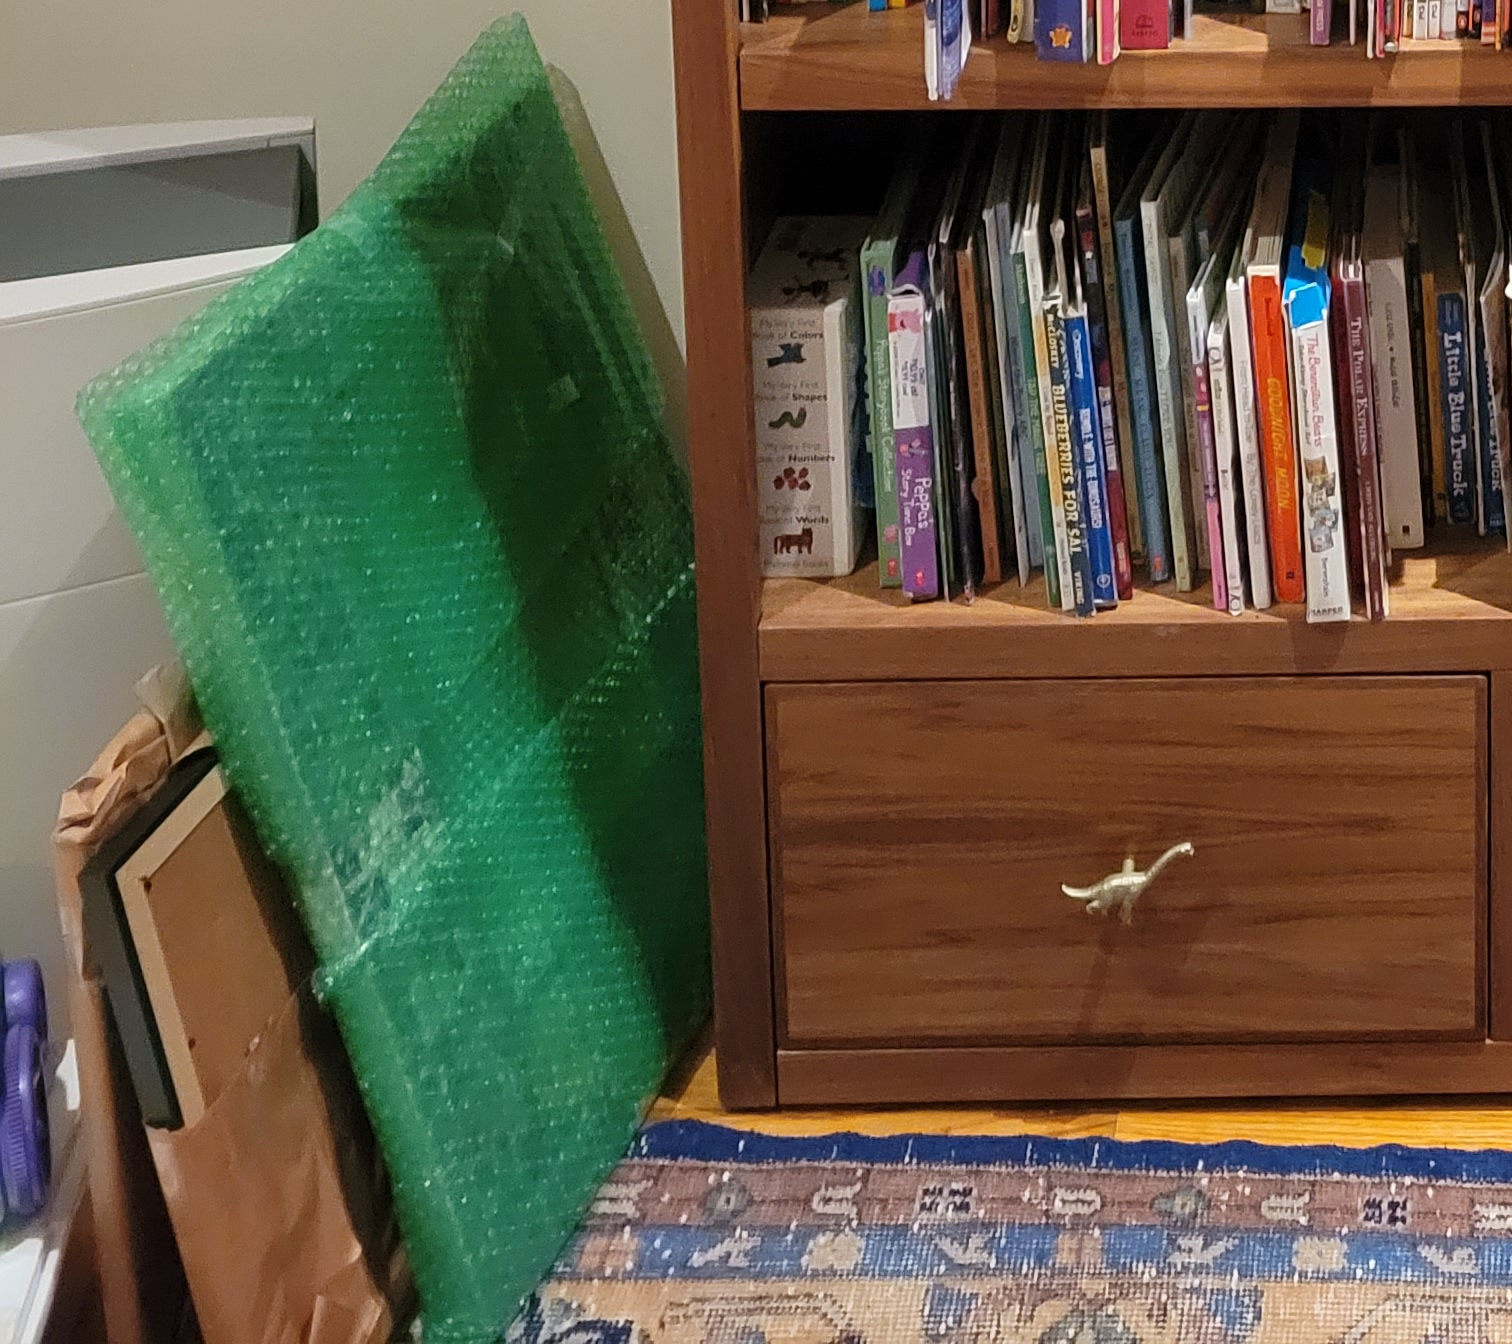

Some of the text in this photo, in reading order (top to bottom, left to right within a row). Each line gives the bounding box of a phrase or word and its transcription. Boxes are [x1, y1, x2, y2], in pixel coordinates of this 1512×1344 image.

[1350, 317, 1370, 456] THE POLAR EXPRESS
[1442, 331, 1469, 496] Little Blue Truck
[1051, 384, 1084, 555] BLUEBERRIES FOR SAL
[1274, 466, 1291, 512] MOON
